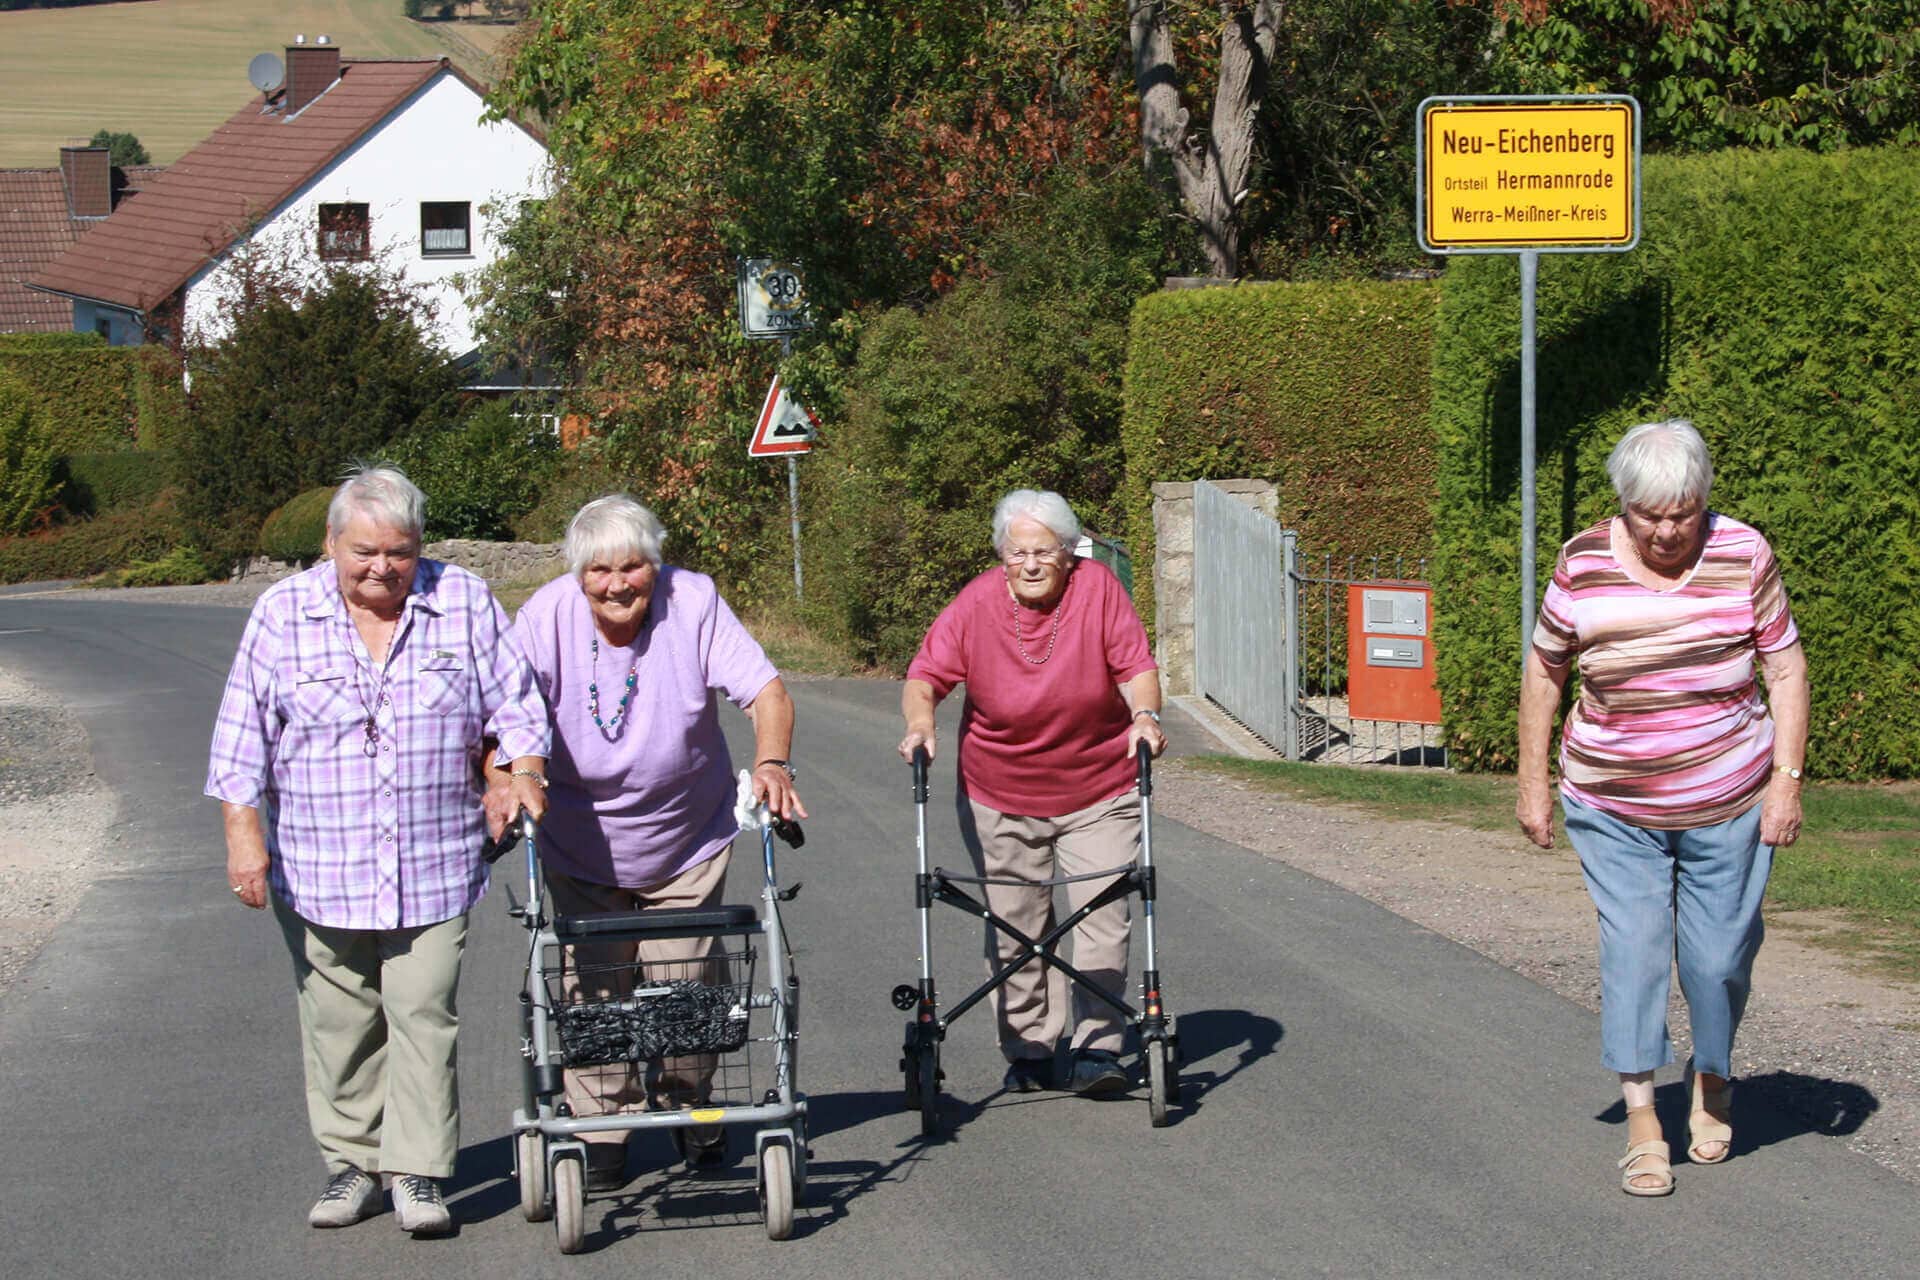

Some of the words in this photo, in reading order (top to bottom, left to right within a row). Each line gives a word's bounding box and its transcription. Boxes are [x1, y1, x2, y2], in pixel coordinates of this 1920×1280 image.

[1443, 128, 1615, 159] Neu-Eichenberg
[1444, 177, 1488, 191] Ortsteil
[1497, 168, 1614, 190] Hermannrode
[1451, 204, 1608, 223] Werra-Meißner-Kreis
[768, 275, 797, 298] 30
